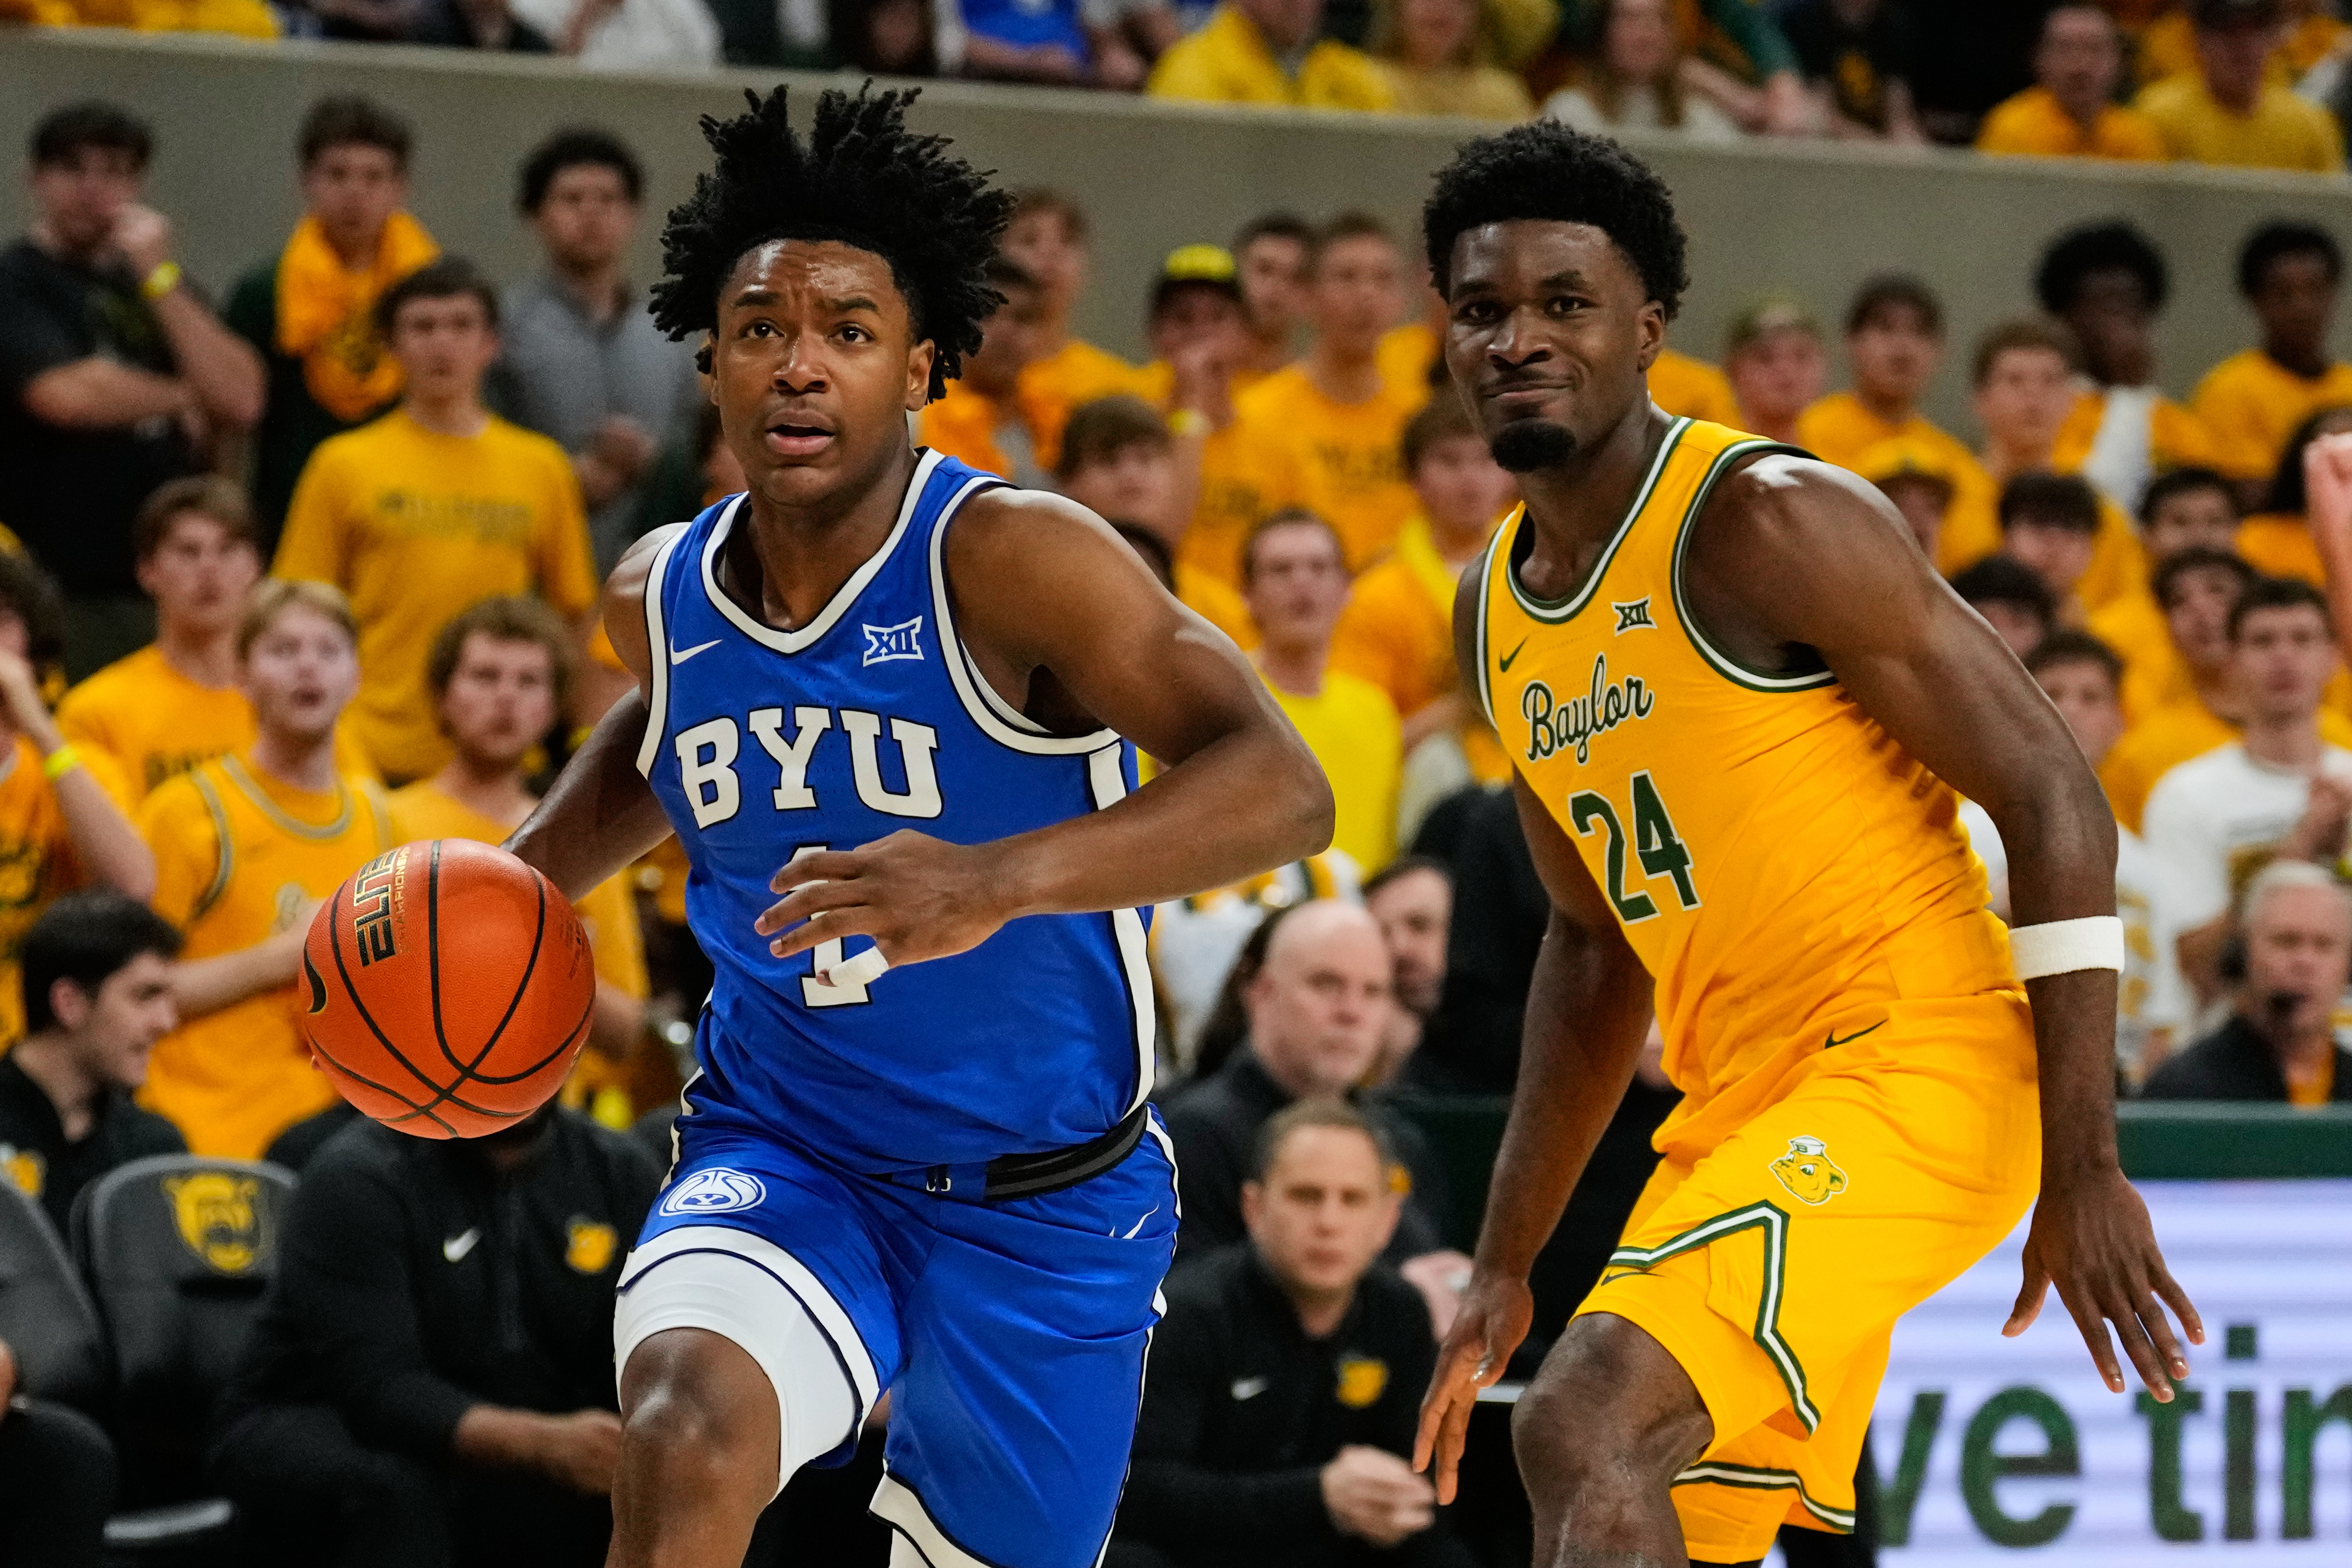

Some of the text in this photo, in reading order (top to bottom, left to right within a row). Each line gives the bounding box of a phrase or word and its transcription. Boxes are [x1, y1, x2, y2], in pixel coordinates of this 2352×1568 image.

[864, 619, 922, 663] XII
[1613, 597, 1655, 634] XII
[674, 705, 943, 830] BYU
[1522, 652, 1654, 765] Baylor
[1568, 769, 1702, 925] 24
[354, 848, 401, 966] ELITE
[789, 843, 871, 1008] 1
